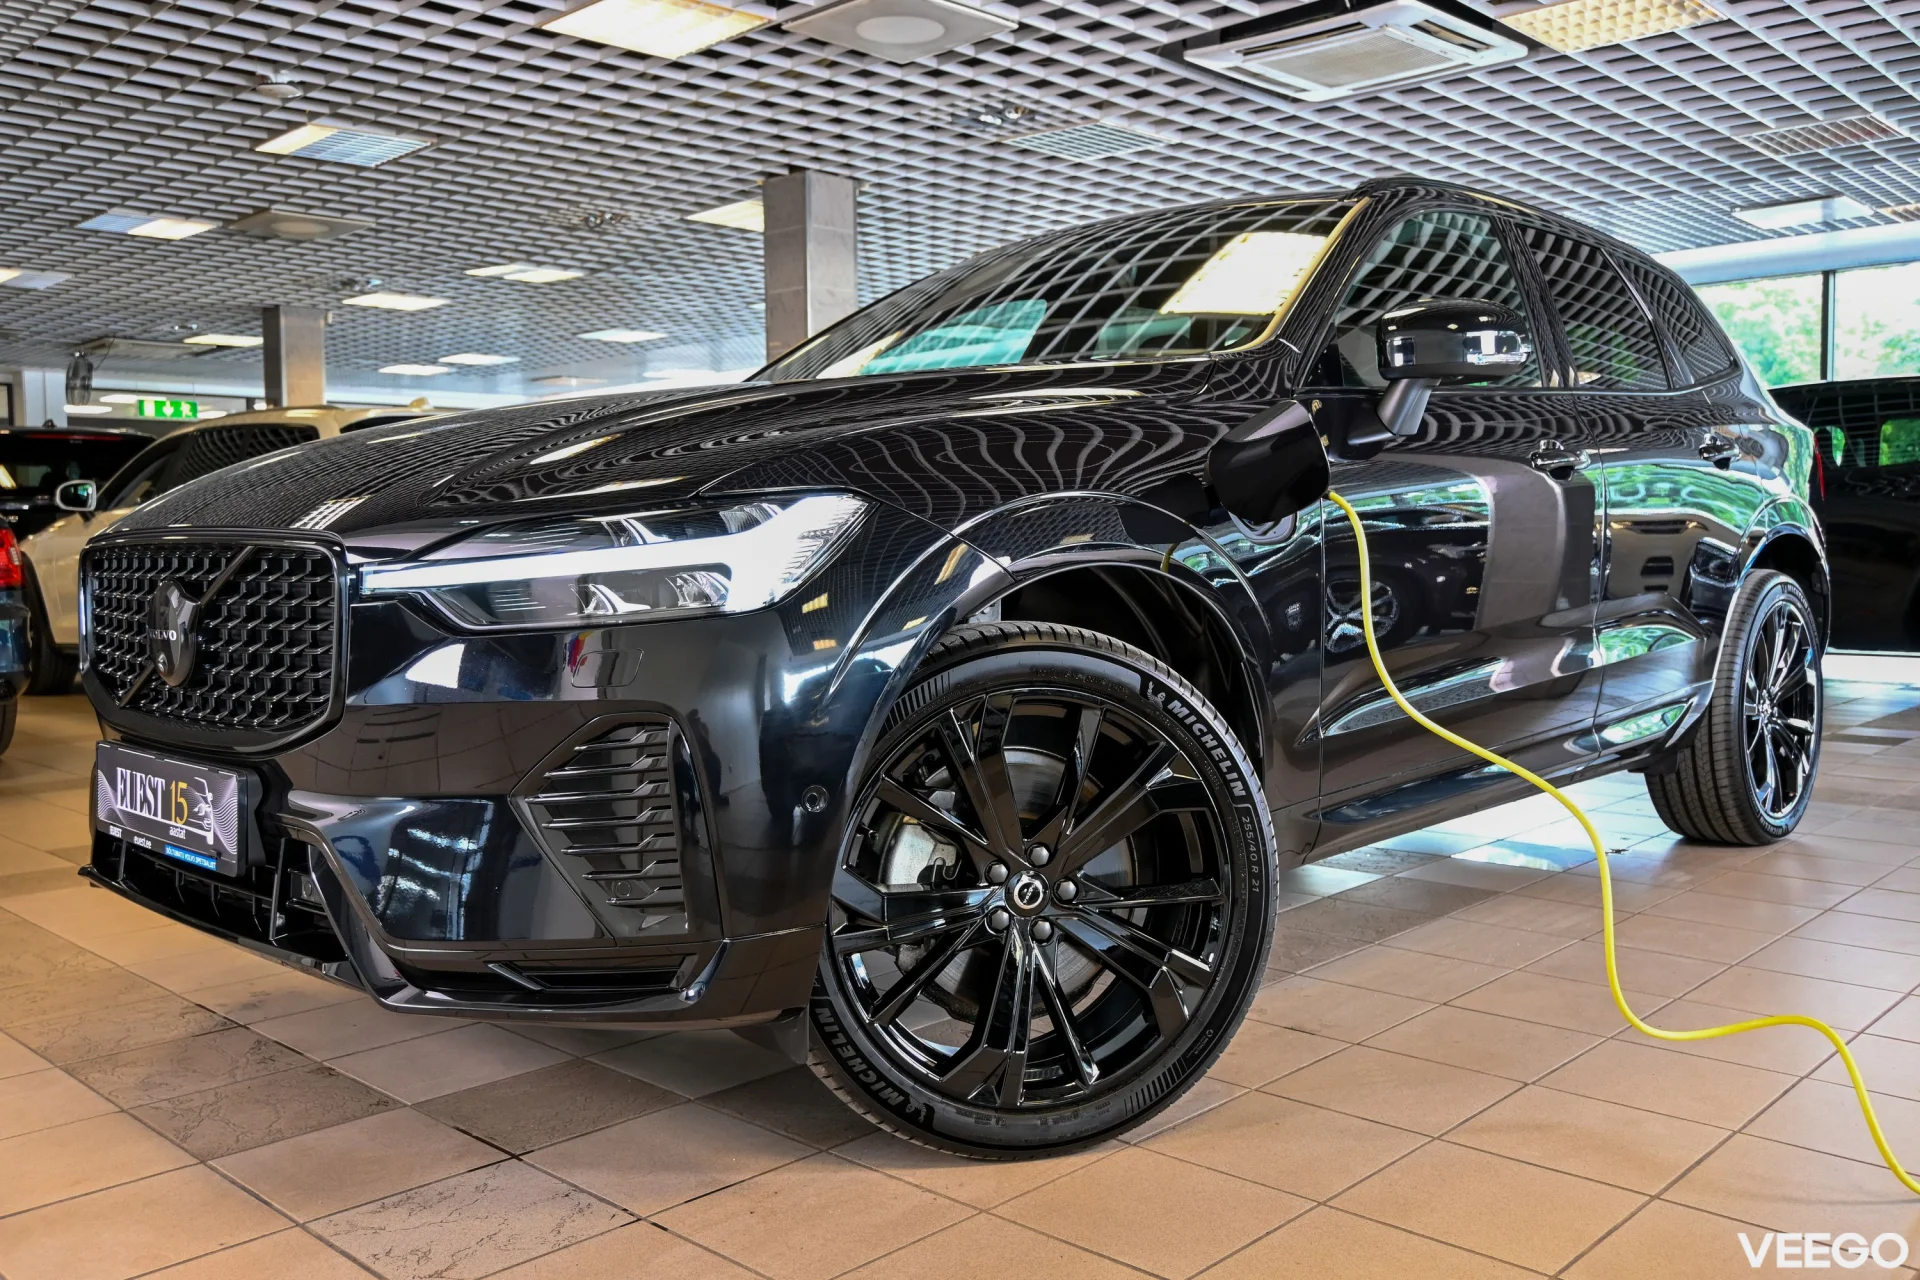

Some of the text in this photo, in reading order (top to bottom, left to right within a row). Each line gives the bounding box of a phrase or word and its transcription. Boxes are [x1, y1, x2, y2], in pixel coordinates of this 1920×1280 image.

[149, 629, 177, 641] VOLVO
[1167, 700, 1246, 797] MICHELIN
[116, 766, 188, 825] EUEST 15
[1241, 816, 1260, 892] 255/40 R 21
[815, 1007, 905, 1107] MICHELIN
